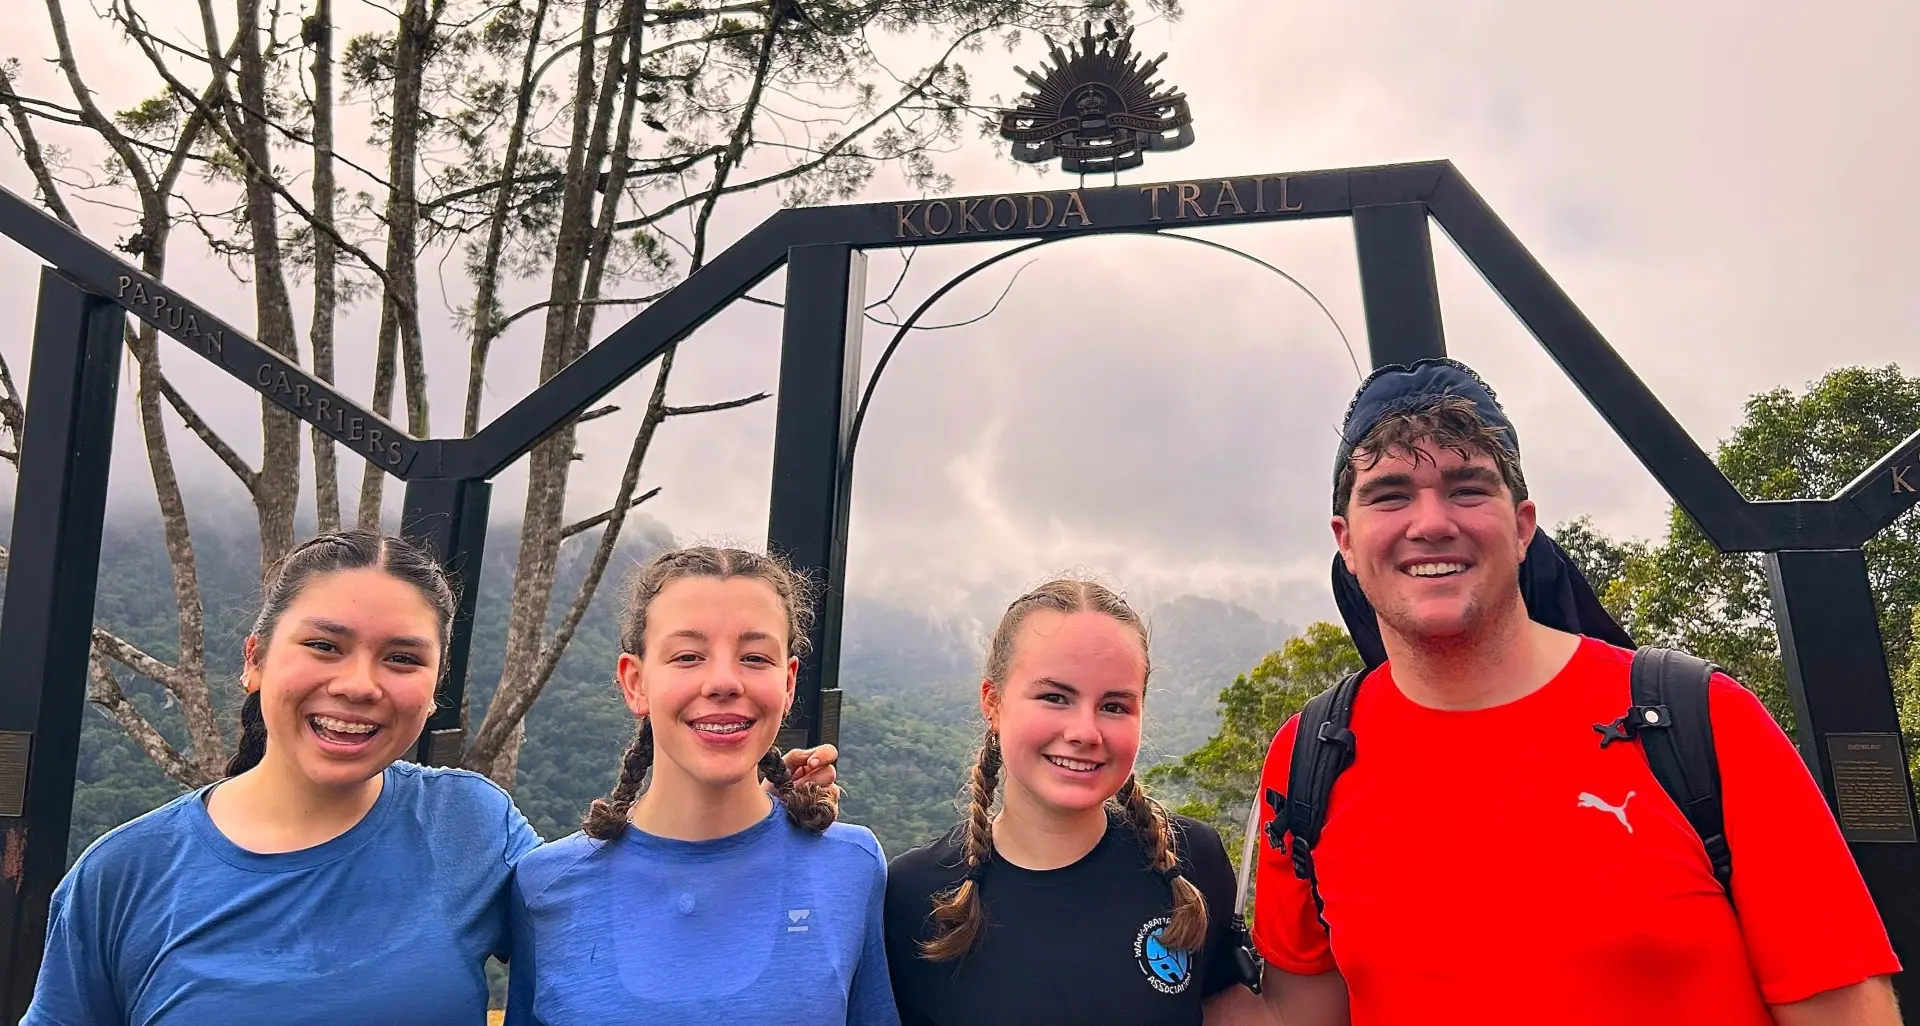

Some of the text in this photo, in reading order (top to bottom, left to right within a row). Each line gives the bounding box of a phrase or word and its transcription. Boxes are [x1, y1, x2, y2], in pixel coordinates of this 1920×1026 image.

[1014, 121, 1069, 140] AUSTRALIAN
[1112, 116, 1184, 131] COMMONWEALTH
[894, 176, 1303, 238] KOKODA TRAIL
[118, 275, 402, 466] PAPUAN CARRIERS
[1889, 455, 1920, 493] K
[1147, 973, 1191, 994] ASSOCIATION
